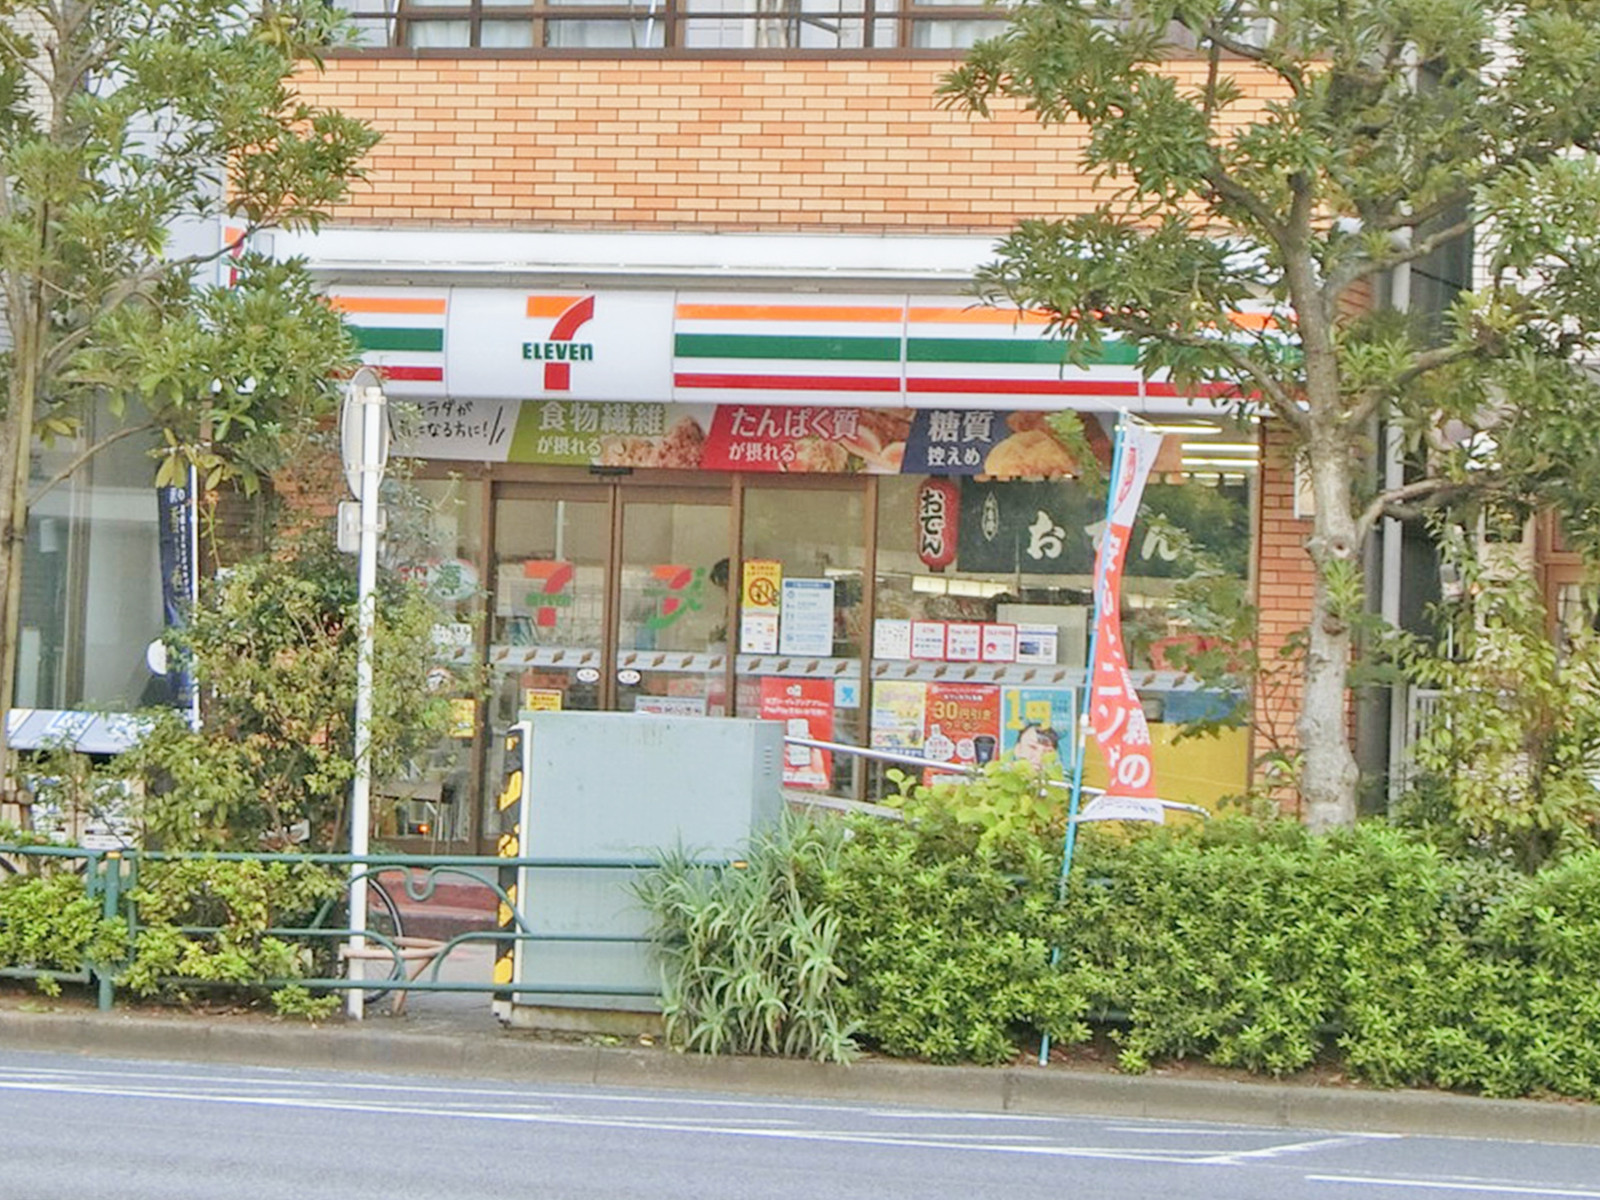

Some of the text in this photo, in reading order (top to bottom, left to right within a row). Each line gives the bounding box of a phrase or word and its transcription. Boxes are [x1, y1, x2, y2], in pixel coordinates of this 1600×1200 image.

[526, 295, 595, 390] 7
[538, 402, 664, 434] 食物繊維
[731, 407, 859, 440] たんぱく質
[928, 410, 995, 442] 糖質
[537, 436, 600, 456] が摂れる
[729, 442, 796, 462] が摂れる
[927, 446, 981, 466] 控えめ
[919, 487, 945, 558] おでん
